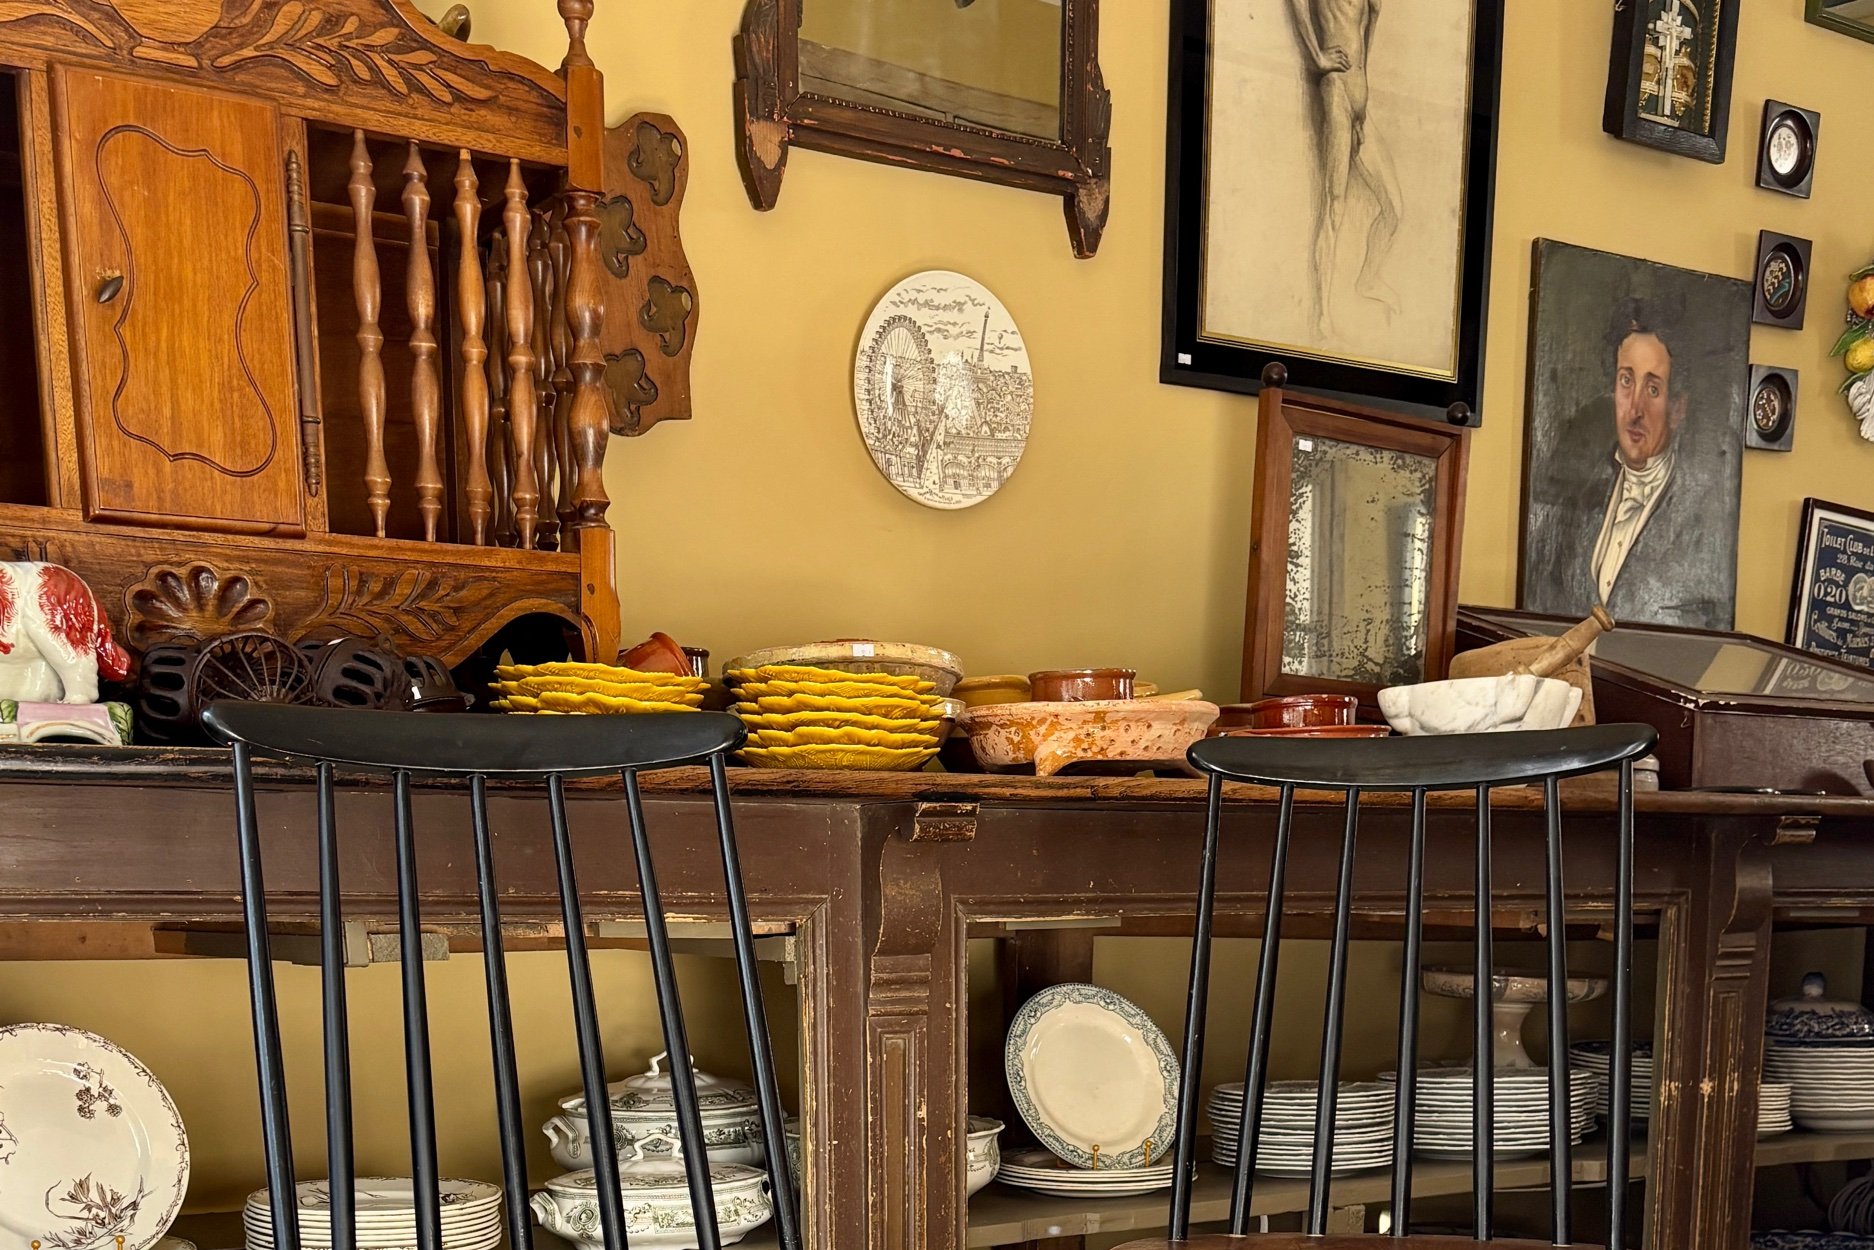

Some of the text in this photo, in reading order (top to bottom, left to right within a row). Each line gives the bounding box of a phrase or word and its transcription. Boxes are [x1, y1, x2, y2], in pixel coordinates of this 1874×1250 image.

[1821, 528, 1845, 551] TOILET
[1846, 535, 1863, 555] CLUB
[1819, 567, 1846, 585] BARBE
